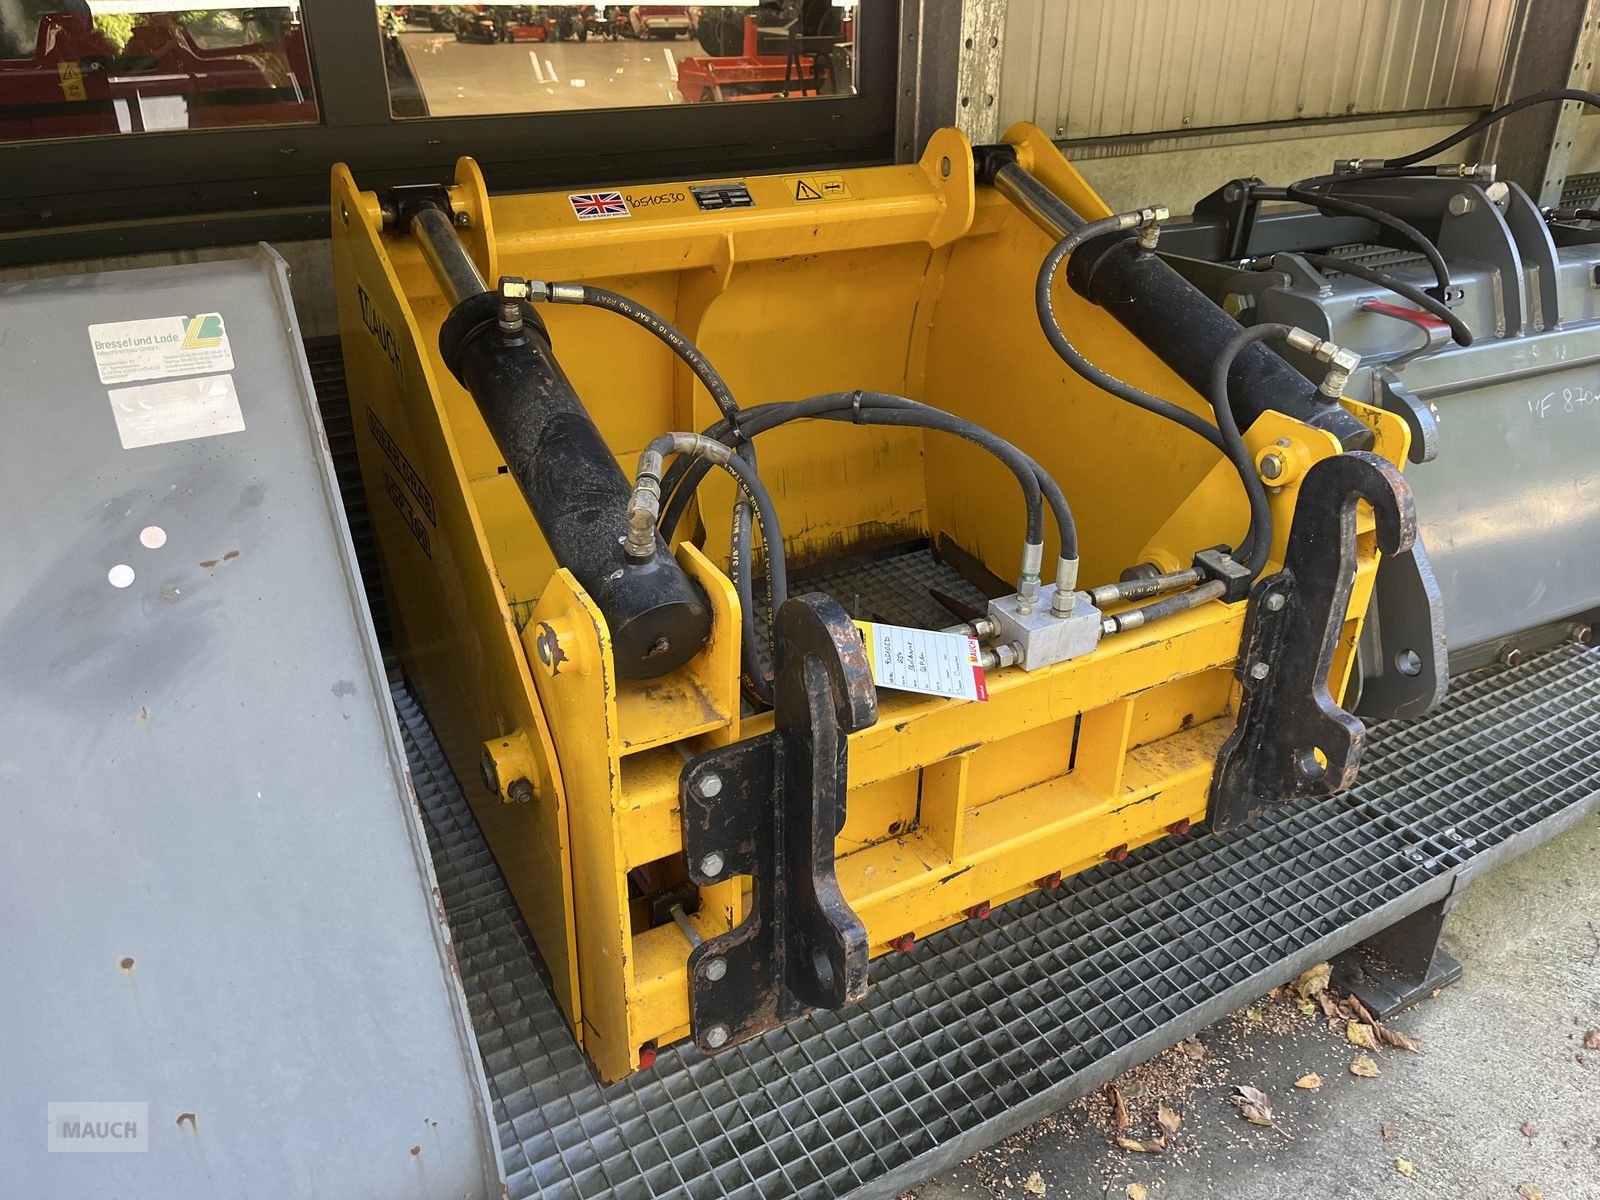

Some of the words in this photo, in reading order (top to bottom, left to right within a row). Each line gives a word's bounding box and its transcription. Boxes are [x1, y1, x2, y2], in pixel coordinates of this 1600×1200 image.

[626, 193, 685, 208] 90510530
[357, 283, 404, 378] MAUCH
[658, 325, 668, 335] 10
[95, 337, 132, 350] Bressel
[134, 335, 153, 346] und
[155, 333, 179, 344] Lade
[668, 333, 684, 347] 2SN
[741, 483, 751, 493] IN
[749, 495, 763, 520] MADE
[733, 513, 741, 534] MADE
[1122, 589, 1135, 597] ITAL
[967, 640, 978, 663] MAUCH
